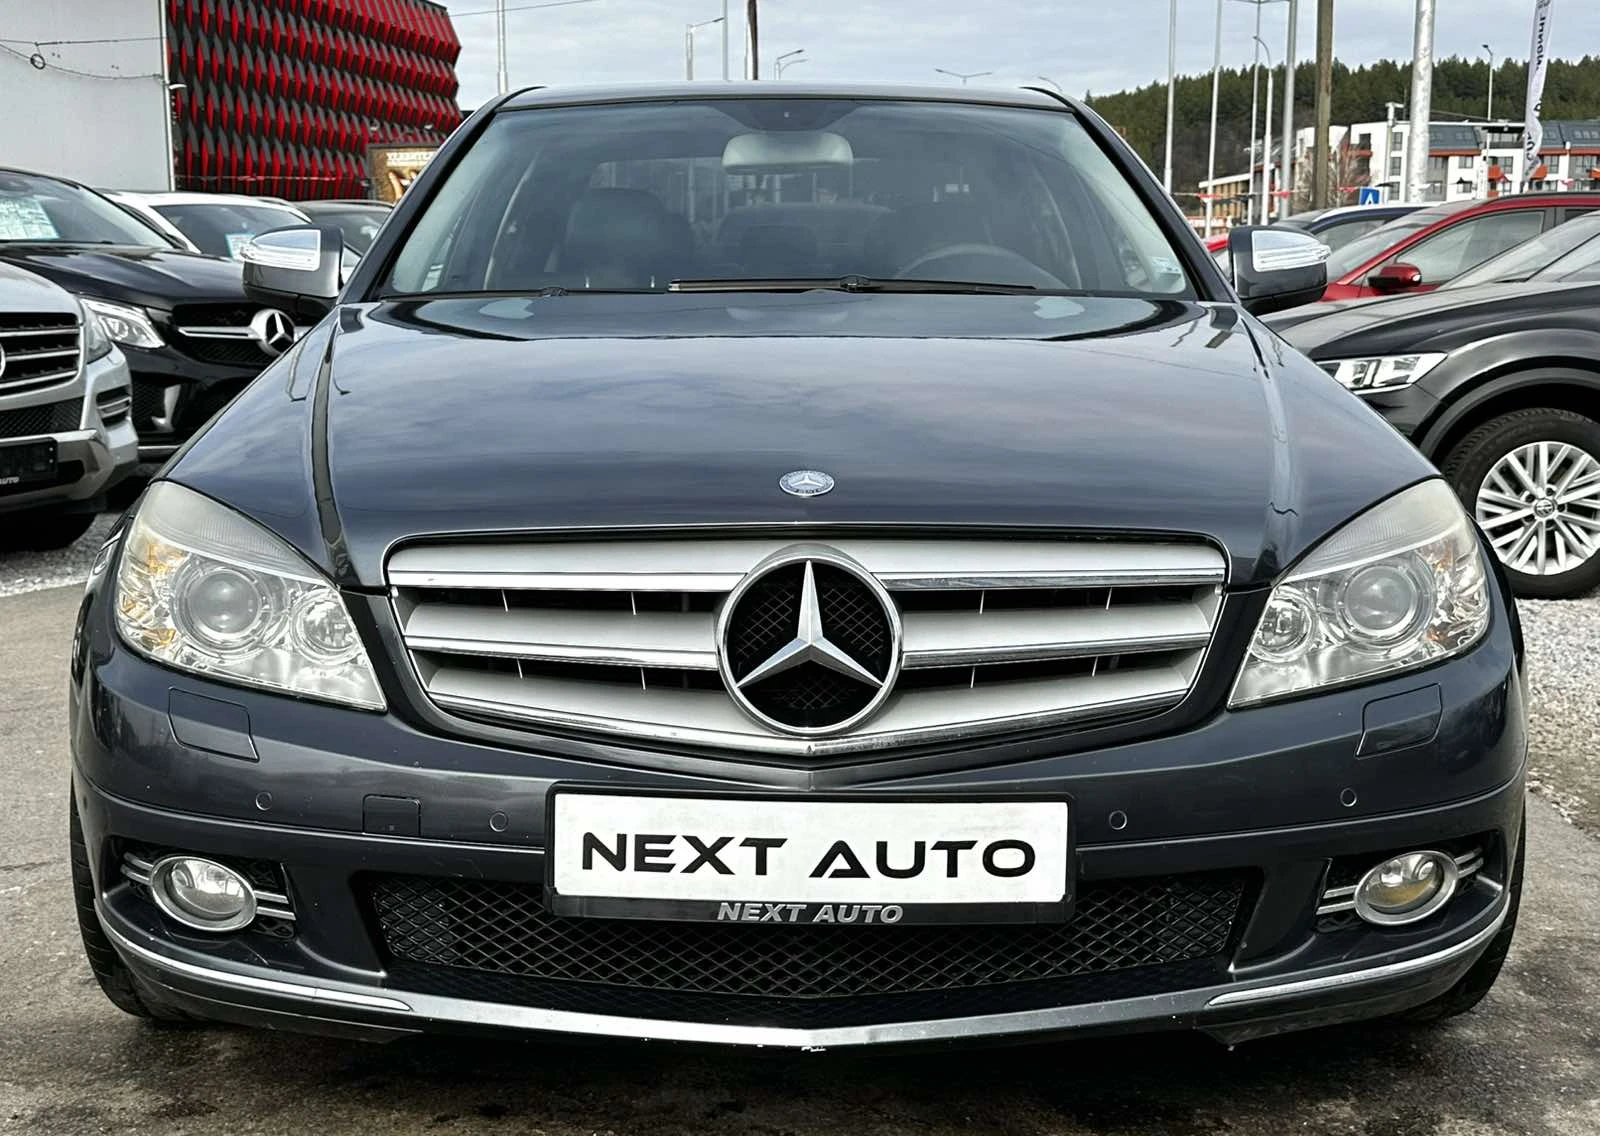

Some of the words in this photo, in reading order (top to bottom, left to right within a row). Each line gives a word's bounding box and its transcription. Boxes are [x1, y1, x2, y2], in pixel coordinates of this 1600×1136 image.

[582, 831, 788, 876] NEXT
[808, 839, 1036, 879] AUTO
[717, 901, 808, 922] NEXT
[812, 903, 904, 924] AUTO
